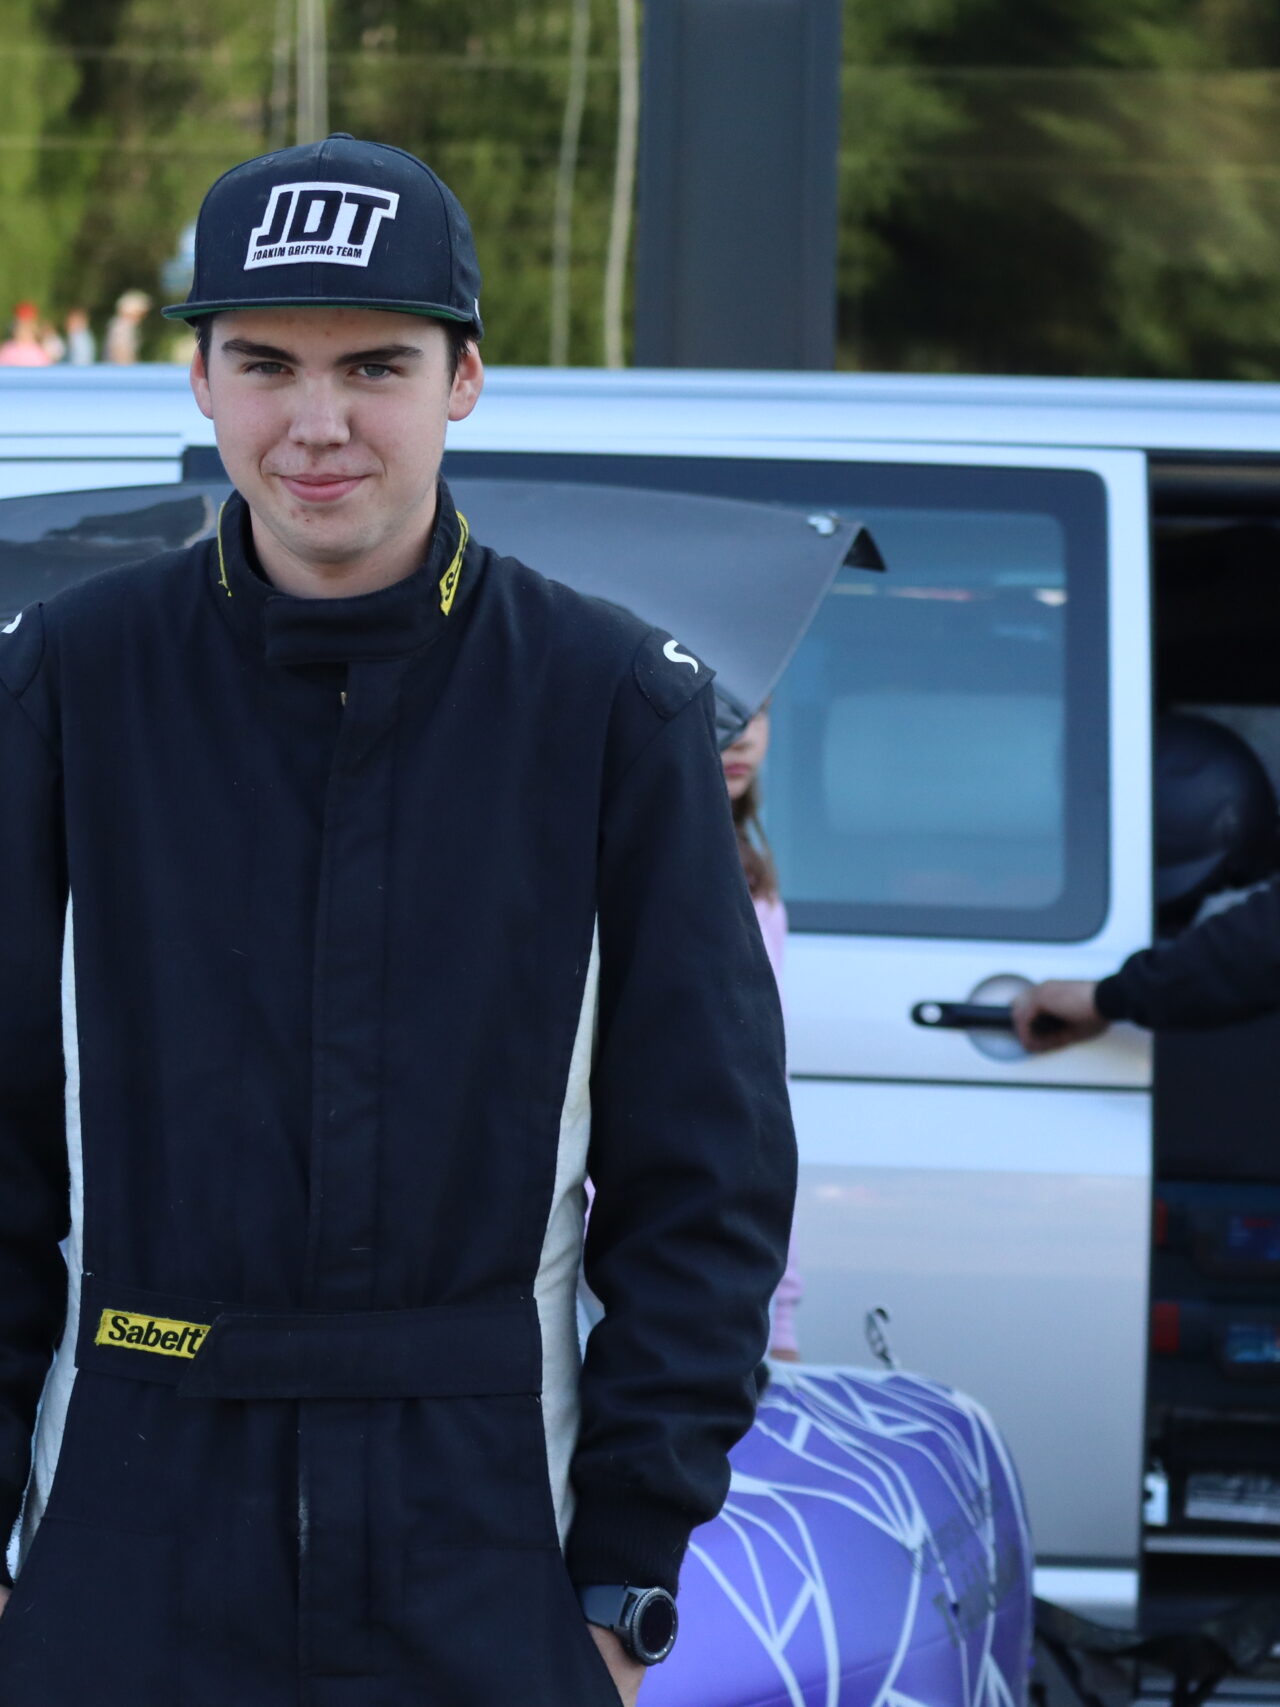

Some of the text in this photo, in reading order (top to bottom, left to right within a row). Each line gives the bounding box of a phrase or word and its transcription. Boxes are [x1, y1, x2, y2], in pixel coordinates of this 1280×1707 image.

[255, 189, 391, 247] JDT
[252, 244, 363, 261] JOAKIM DRIFTING TEAM
[108, 1315, 202, 1354] Sabelt
